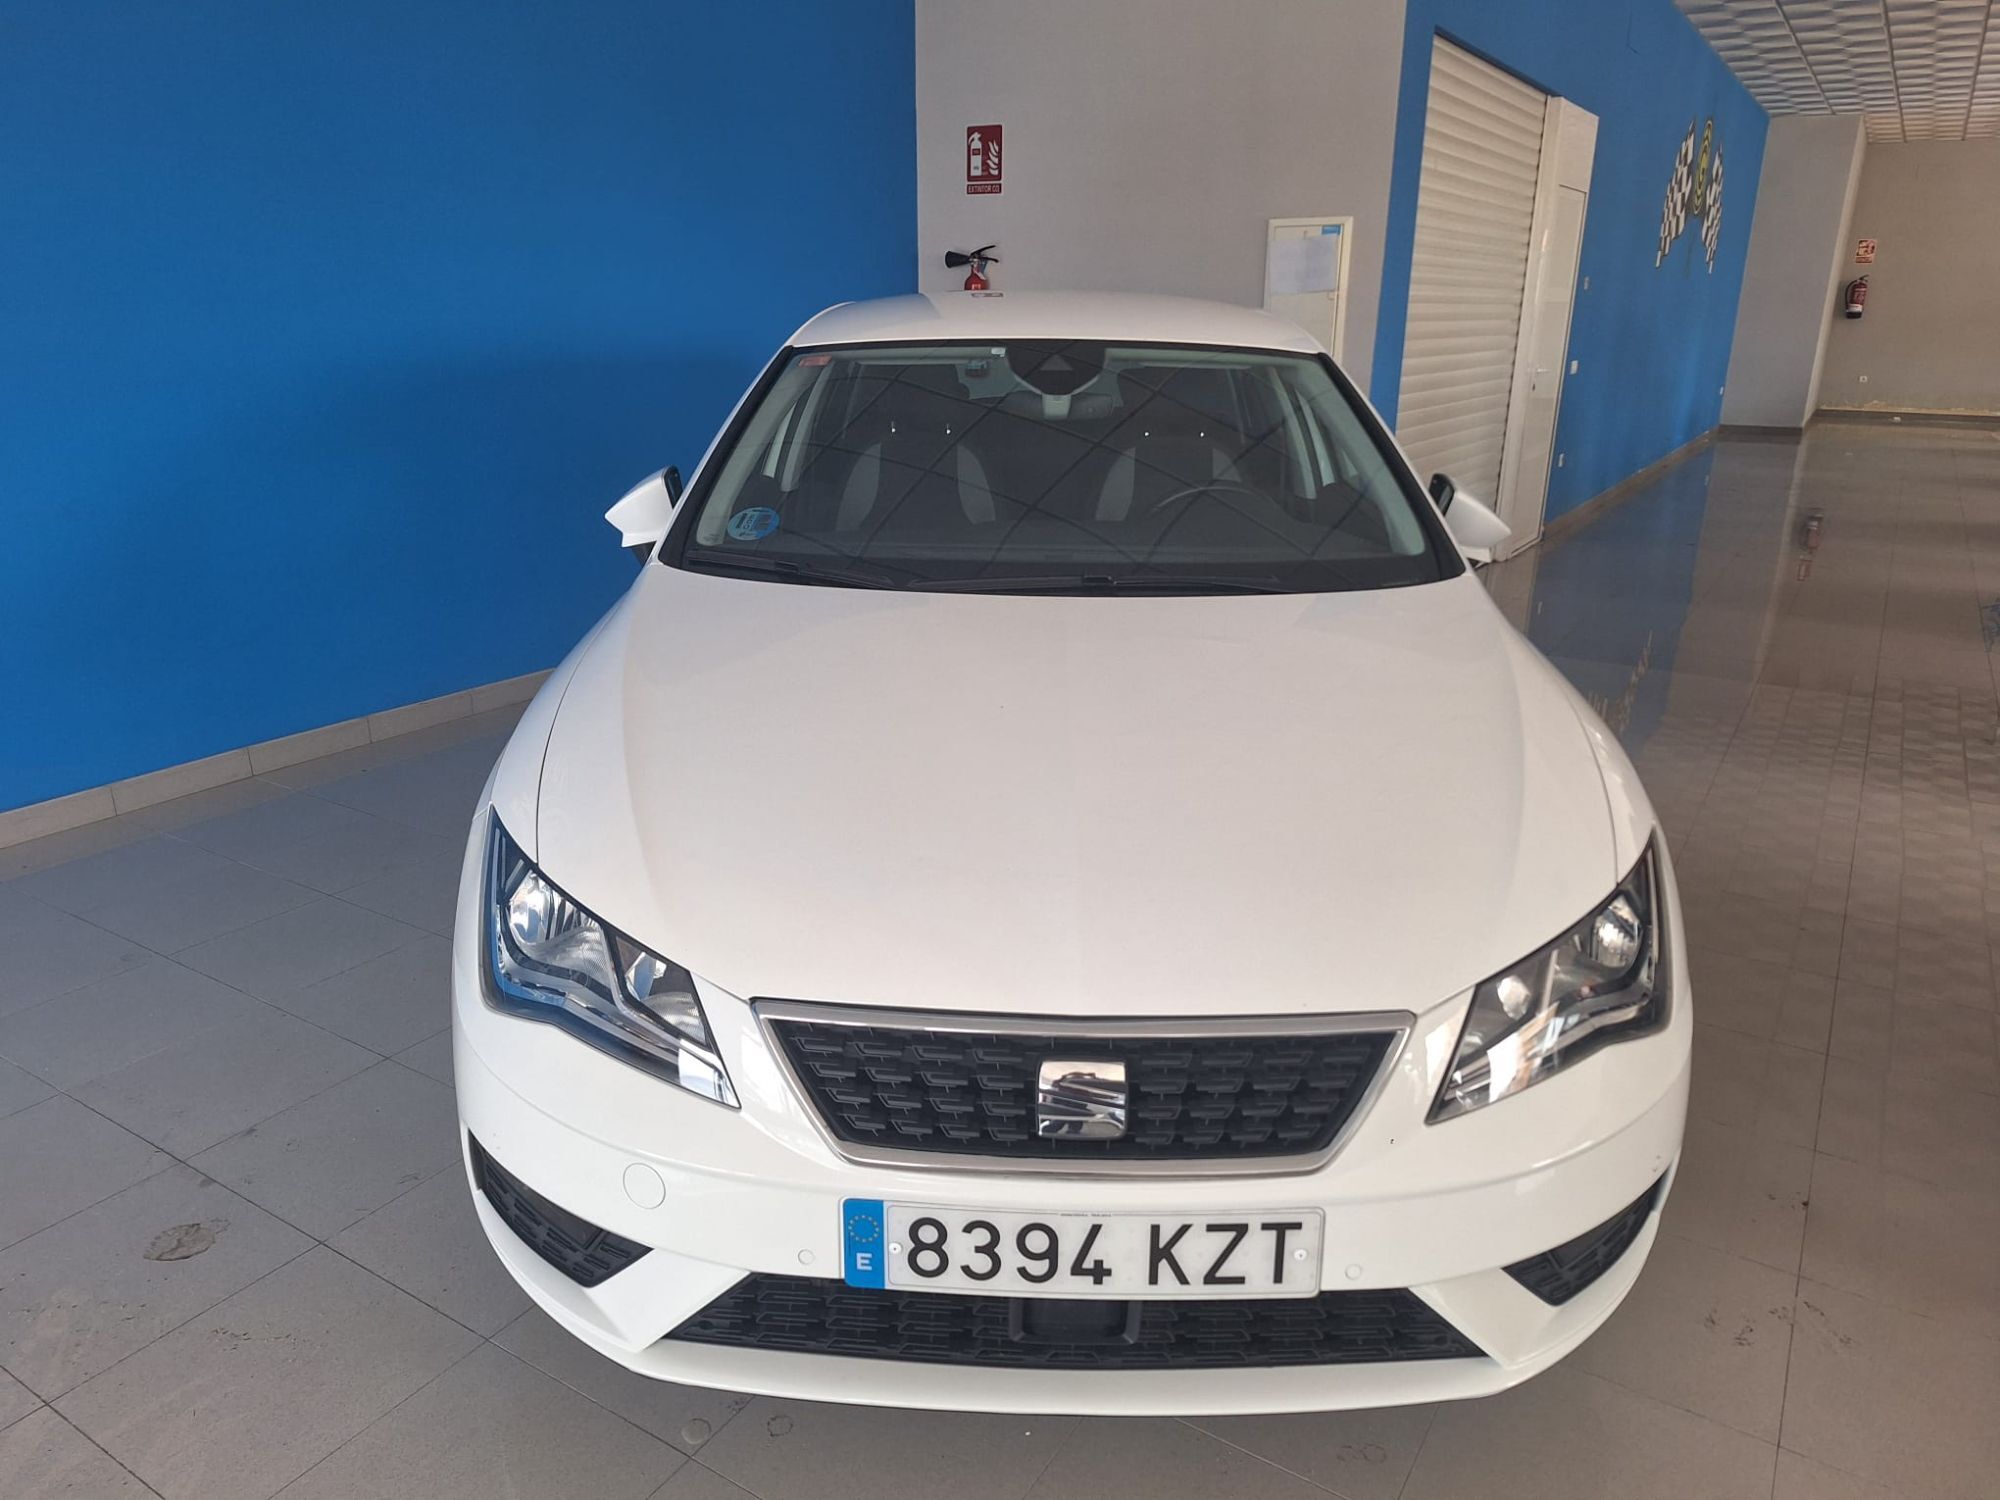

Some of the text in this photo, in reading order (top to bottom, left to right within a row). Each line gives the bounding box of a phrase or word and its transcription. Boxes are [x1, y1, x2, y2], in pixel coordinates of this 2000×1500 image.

[856, 1252, 872, 1270] E
[907, 1217, 1302, 1285] 8394 KZT
